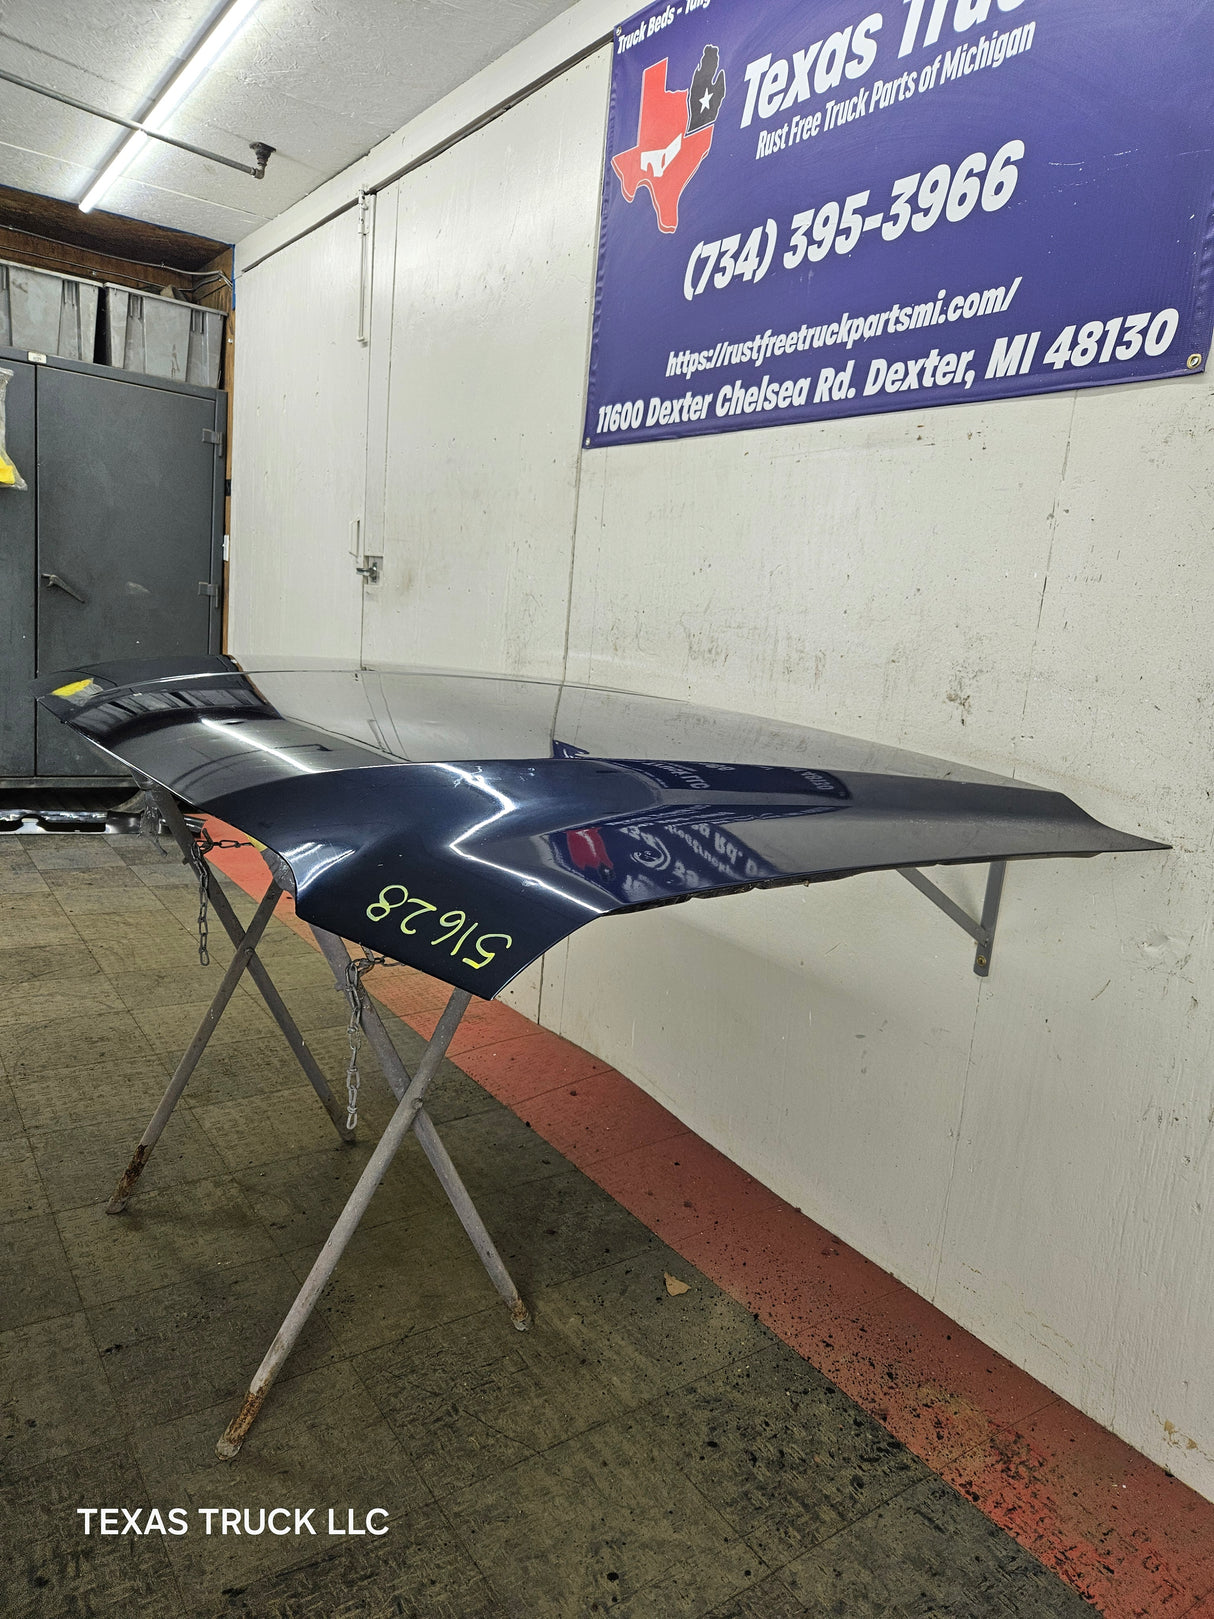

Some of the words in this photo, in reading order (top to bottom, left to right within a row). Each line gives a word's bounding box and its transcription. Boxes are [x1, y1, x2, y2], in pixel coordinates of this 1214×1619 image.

[616, 21, 647, 54] Truck
[647, 5, 675, 37] Beds
[740, 13, 883, 129] Texas
[756, 116, 789, 159] Rust
[788, 111, 822, 146] Free
[823, 88, 869, 131] Truck
[869, 71, 917, 113] Parts
[918, 54, 942, 93] of
[940, 21, 1036, 84] Michigan
[684, 219, 777, 301] (734)
[783, 140, 1025, 269] 395-3966
[597, 400, 644, 433] 11600
[646, 392, 713, 427] Dexter
[715, 375, 811, 417] Chelsea
[813, 360, 856, 403] Rd.
[863, 349, 975, 389] Dexter,
[985, 331, 1042, 379] MI
[1043, 308, 1179, 370] 48130
[666, 277, 1023, 379] https://rustfreetruckpartsmi.com/
[366, 885, 513, 969] 51628
